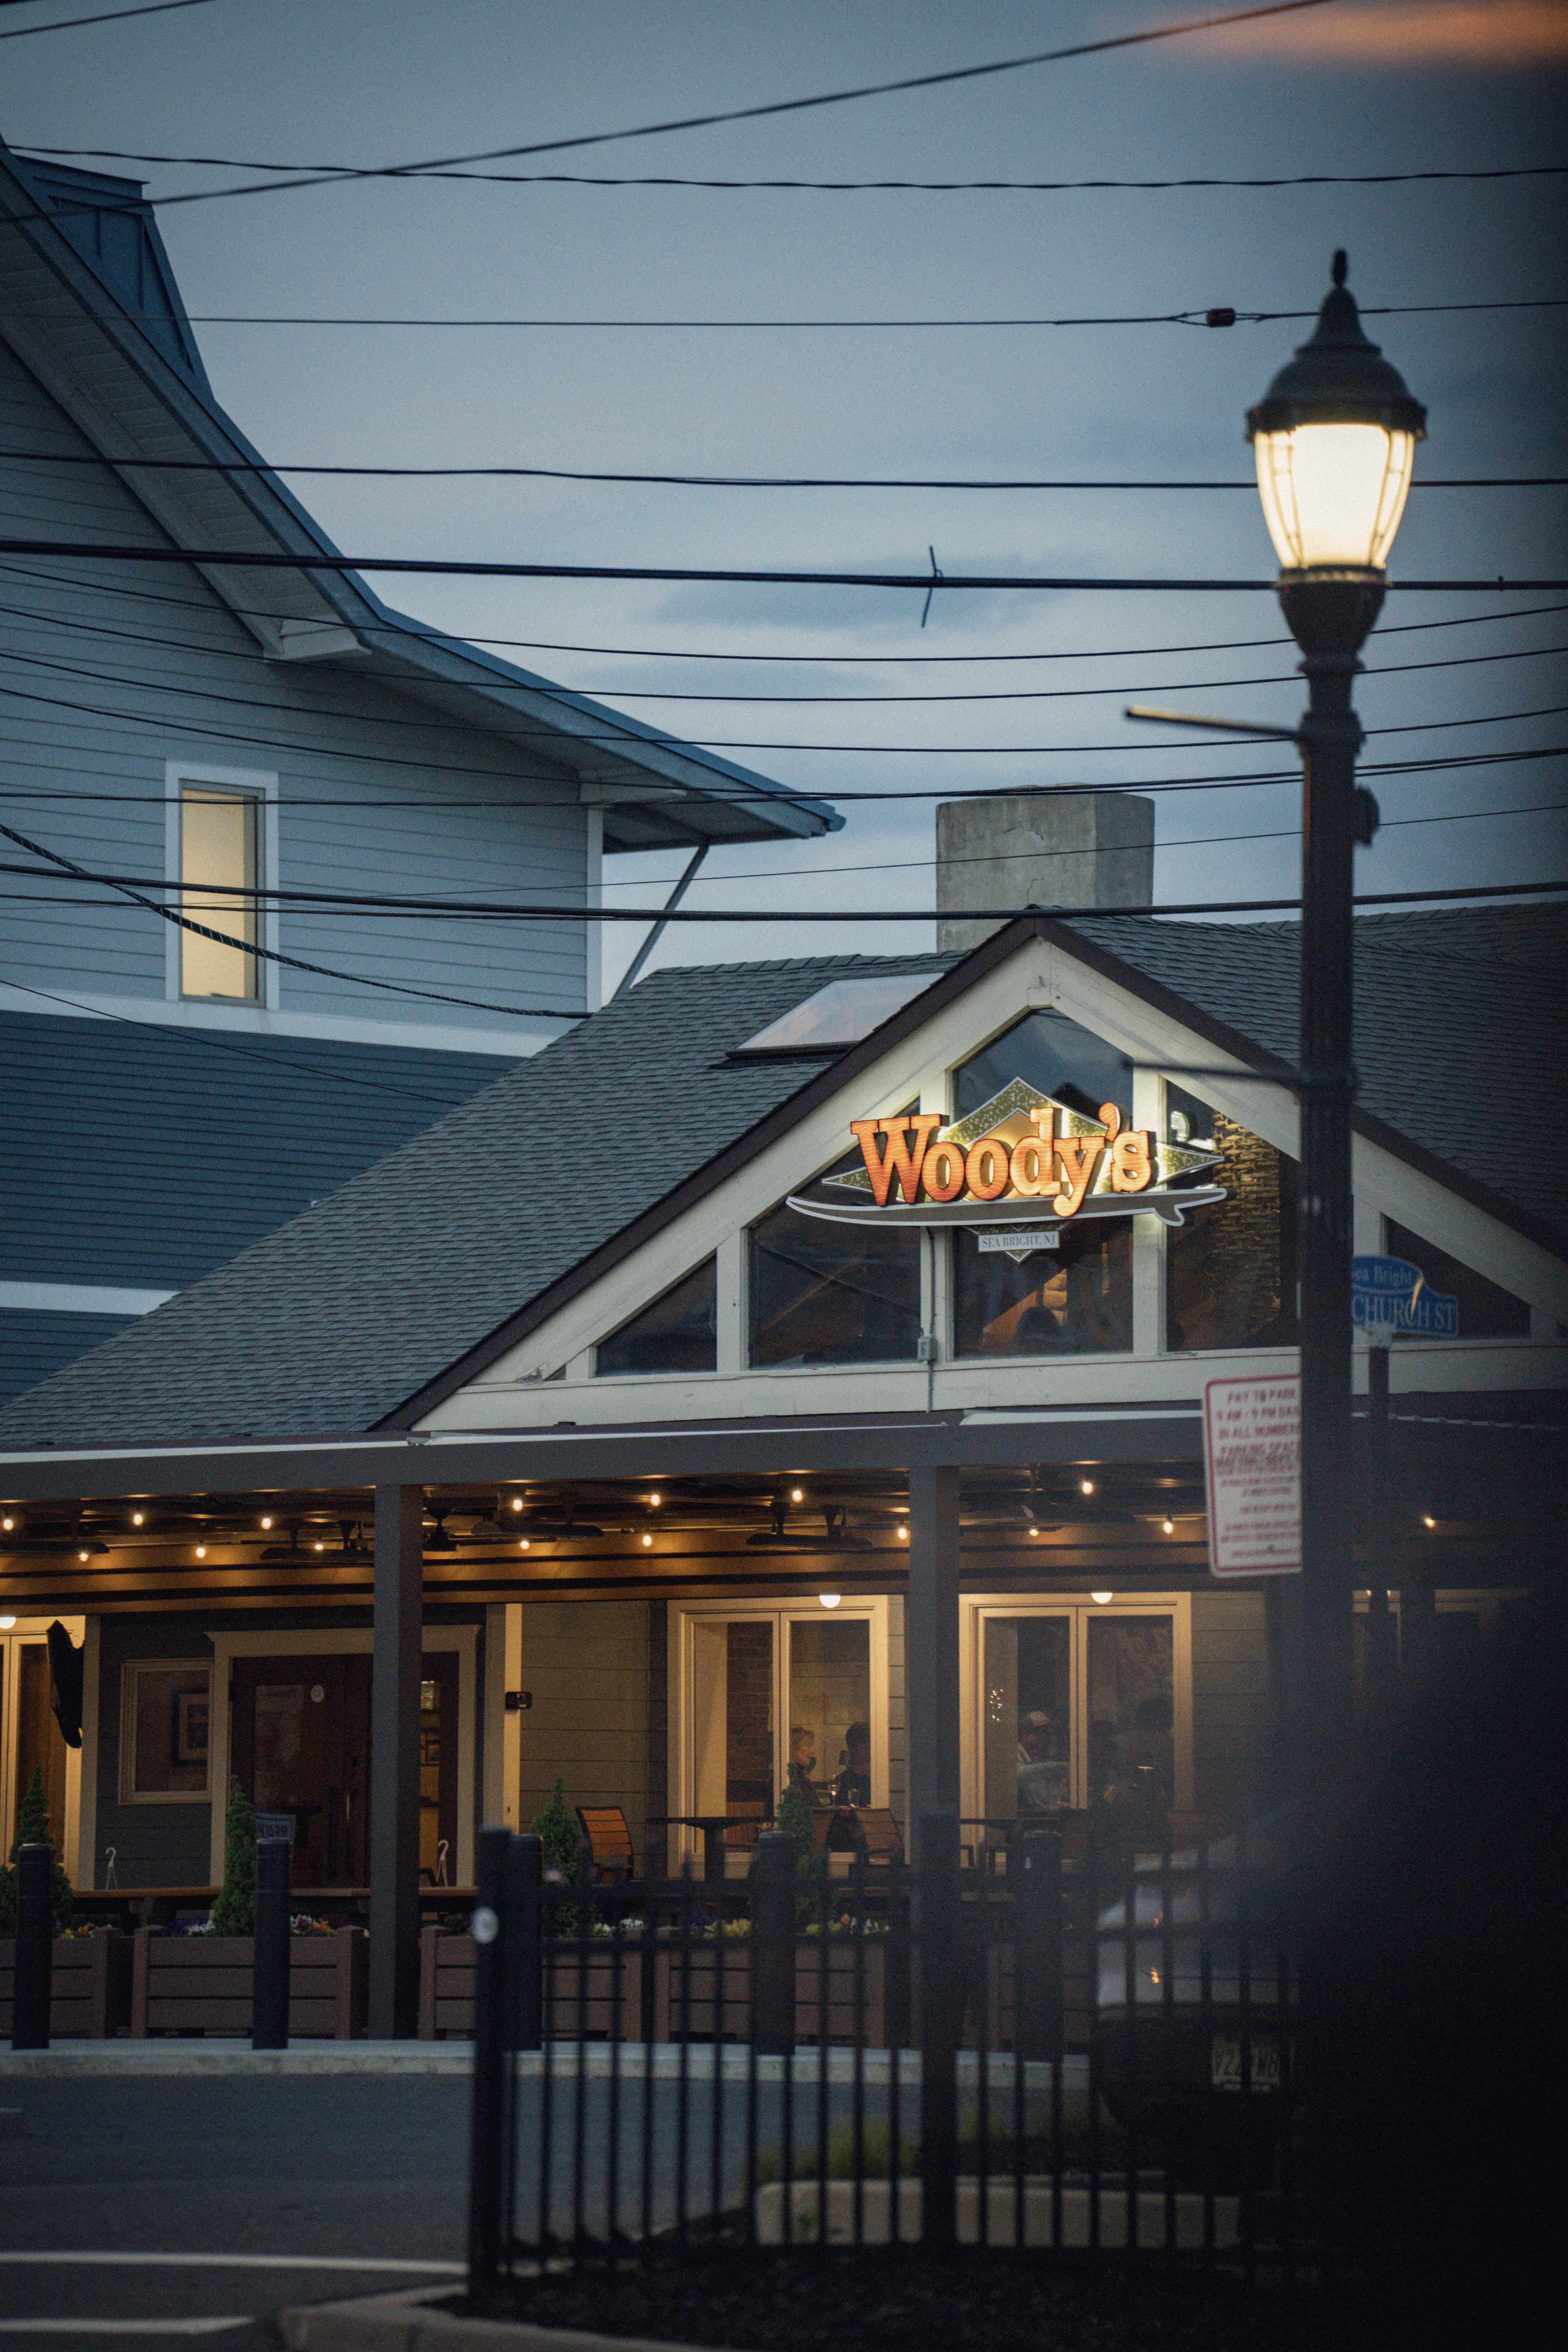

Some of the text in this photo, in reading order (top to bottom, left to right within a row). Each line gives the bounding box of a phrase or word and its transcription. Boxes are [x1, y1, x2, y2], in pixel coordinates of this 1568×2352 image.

[851, 1102, 1152, 1217] Woody's
[983, 1238, 1000, 1248] SEA
[1045, 1234, 1055, 1245] NJ
[1374, 1265, 1412, 1287] Bright
[1352, 1295, 1456, 1330] CHURCH ST
[1228, 1391, 1249, 1402] PAY
[1269, 1388, 1295, 1399] PARK
[1233, 1426, 1252, 1439] ALL
